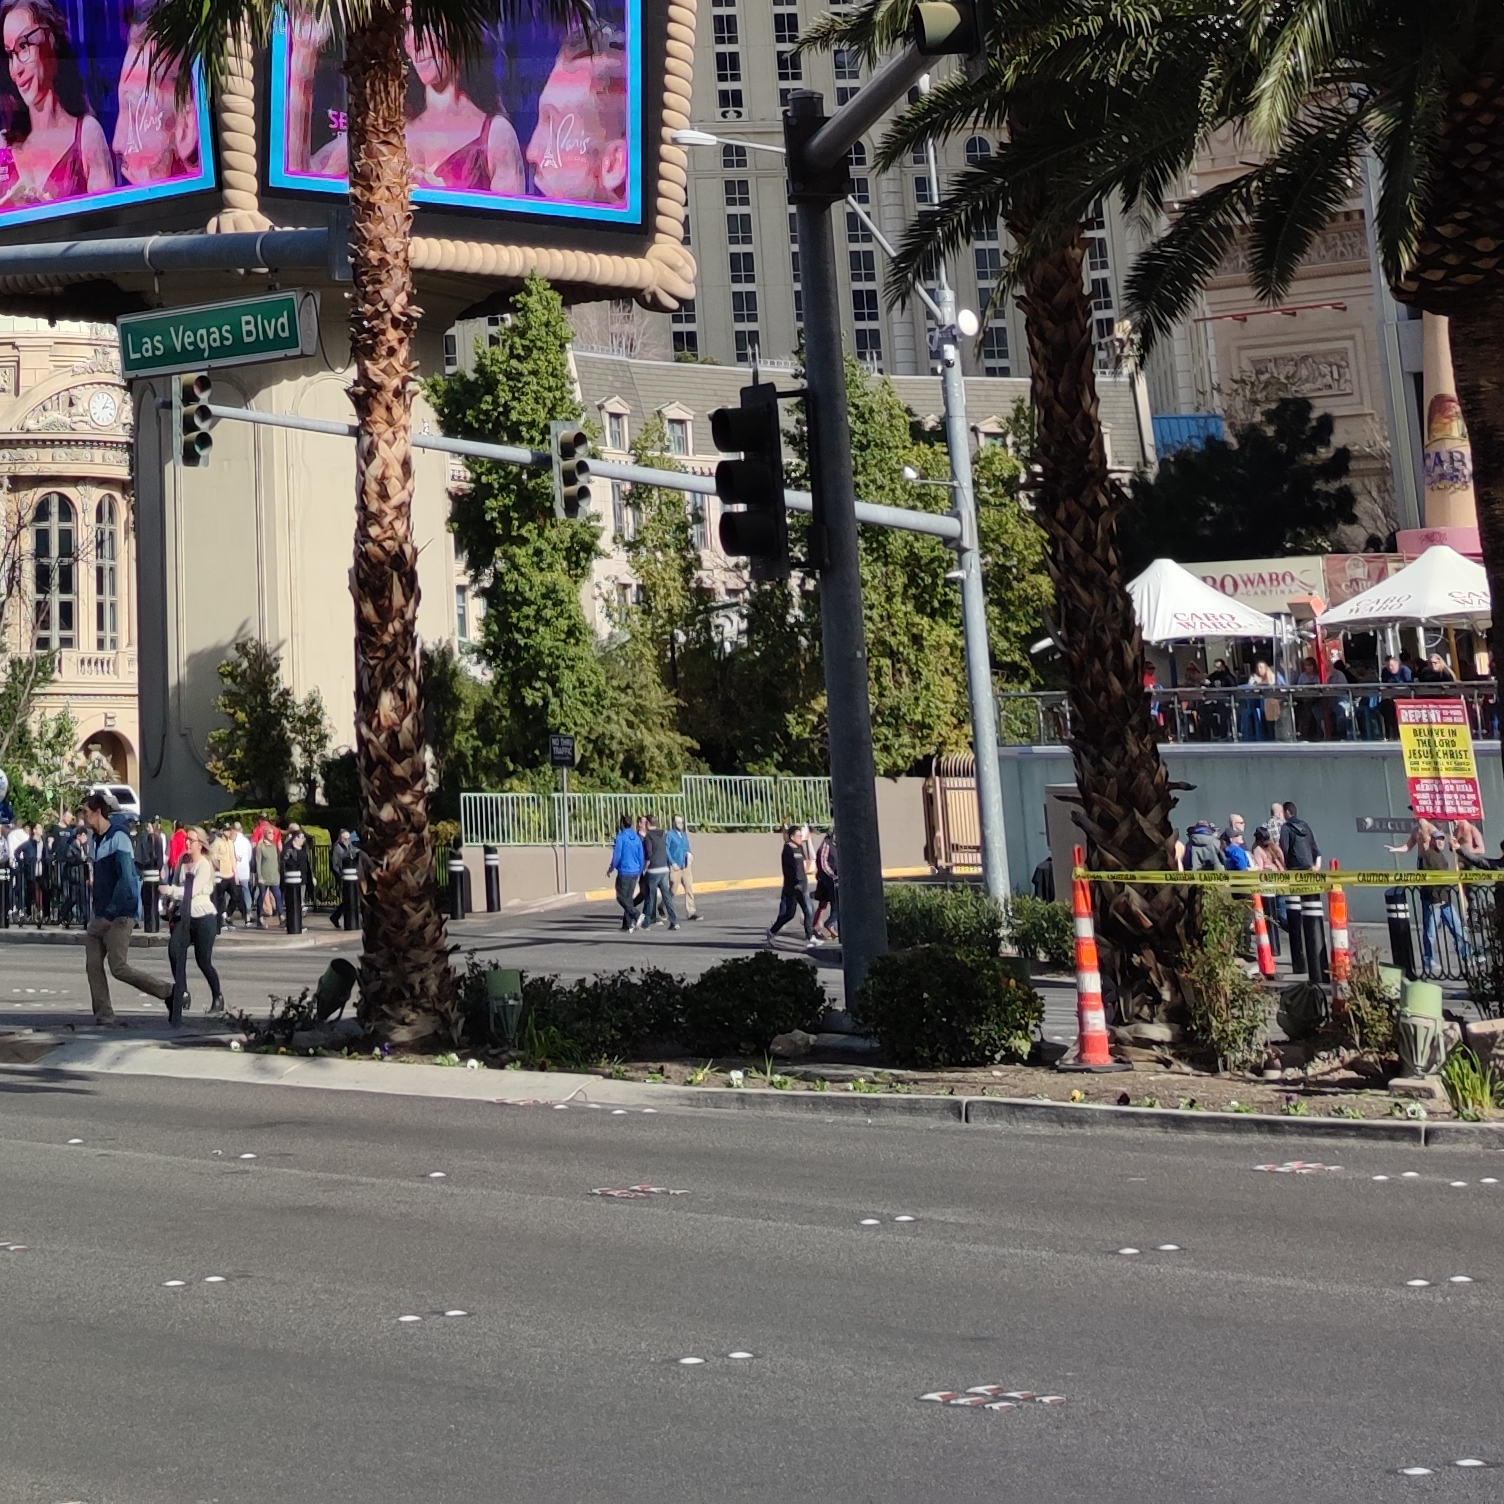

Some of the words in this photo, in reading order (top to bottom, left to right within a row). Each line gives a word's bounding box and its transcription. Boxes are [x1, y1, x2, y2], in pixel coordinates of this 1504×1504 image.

[127, 332, 164, 360] Las
[169, 323, 233, 358] Vegas
[240, 309, 290, 343] Blvd
[1238, 570, 1296, 589] WABO
[1355, 594, 1412, 607] CABO
[1173, 612, 1236, 622] CABO
[1176, 621, 1241, 632] WABO
[1448, 728, 1457, 737] IN
[1433, 739, 1457, 748] LORD
[1437, 750, 1469, 760] CHRIST
[1199, 872, 1230, 882] CAUTION
[1259, 873, 1291, 883] CAUTION
[1294, 873, 1327, 883] CAUTION
[1357, 872, 1390, 883] CAUTION
[1393, 872, 1427, 883] CAUTION
